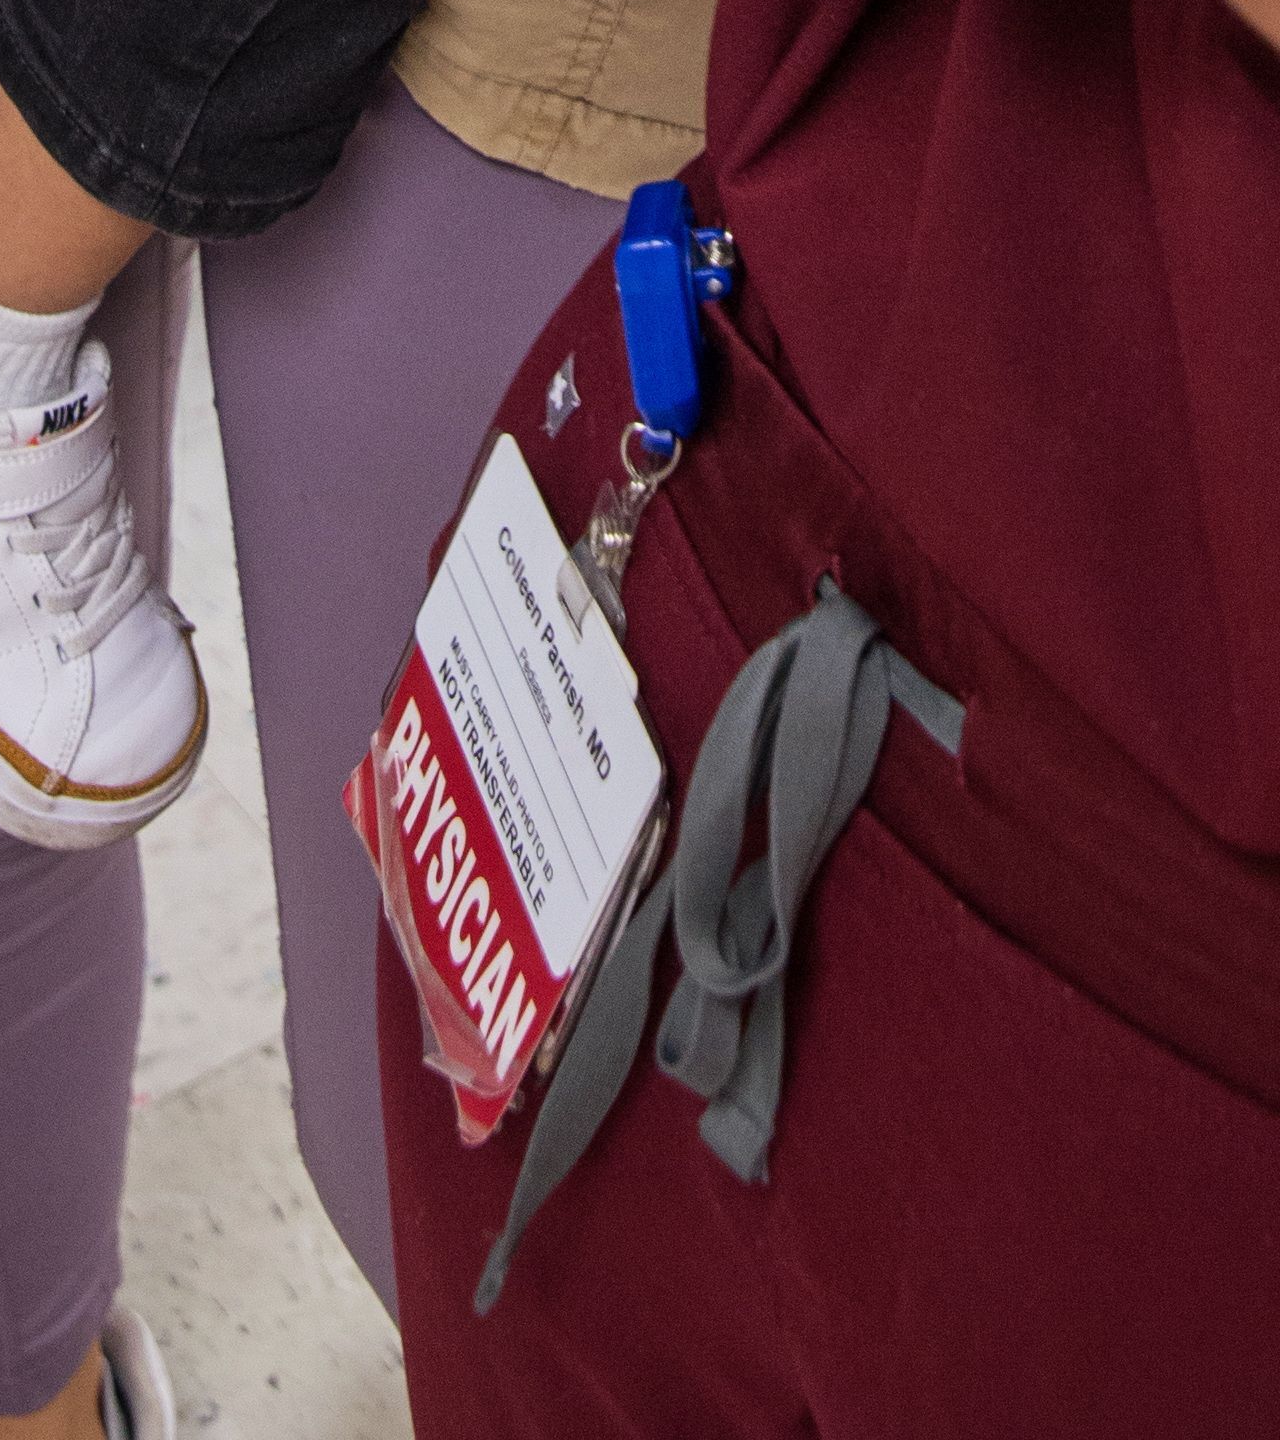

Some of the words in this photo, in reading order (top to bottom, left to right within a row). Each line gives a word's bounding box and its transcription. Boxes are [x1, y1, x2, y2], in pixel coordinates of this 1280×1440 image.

[40, 393, 89, 437] NIKE
[450, 635, 473, 684] MUST
[471, 684, 496, 743] CARRY
[496, 741, 519, 797] VALID
[517, 796, 545, 859] PHOTO
[543, 857, 554, 883] ID
[498, 526, 543, 628] Colleen
[540, 622, 586, 736] Parrish,
[586, 726, 612, 781] MD
[520, 646, 552, 725] Pediatrics
[382, 696, 538, 1081] PHYSICIAN
[439, 657, 466, 713] NOT
[462, 710, 546, 917] TRANSFERABLE
